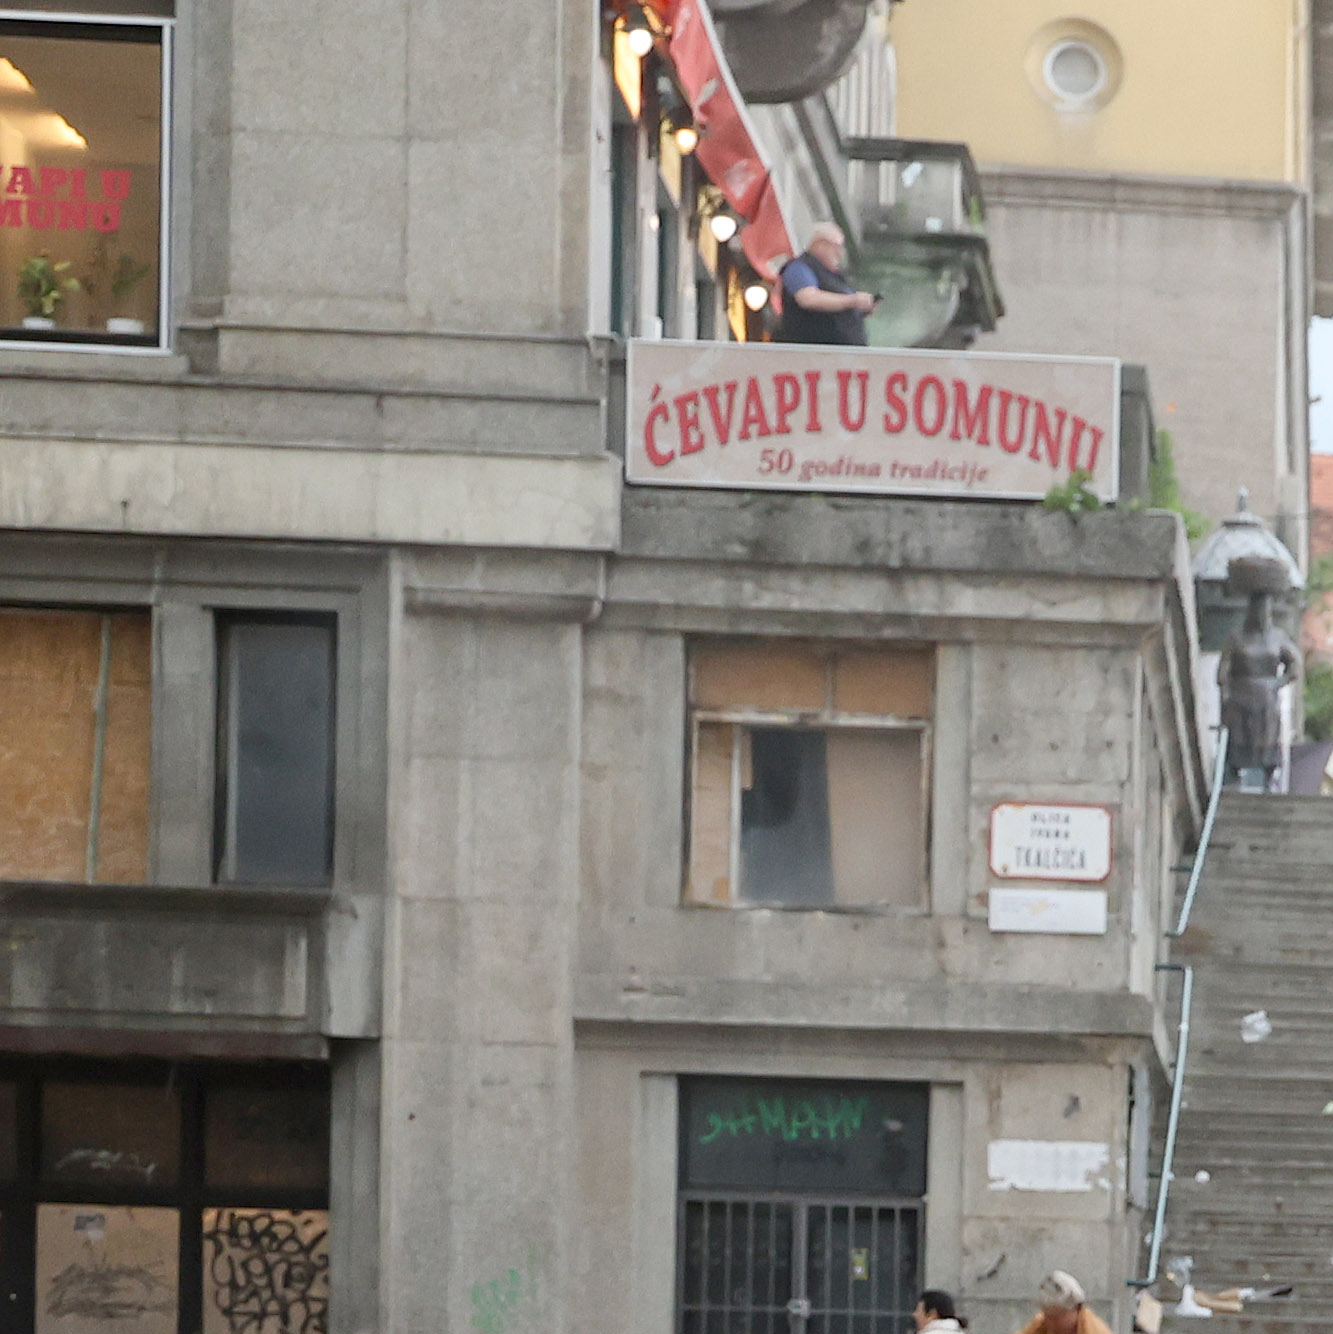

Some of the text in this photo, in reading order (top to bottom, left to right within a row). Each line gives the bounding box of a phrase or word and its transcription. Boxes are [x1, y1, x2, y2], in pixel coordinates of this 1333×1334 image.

[0, 166, 87, 197] API
[643, 370, 1105, 475] ĆEVAPI U SOMUNU
[757, 447, 989, 484] 50 godina tradicije
